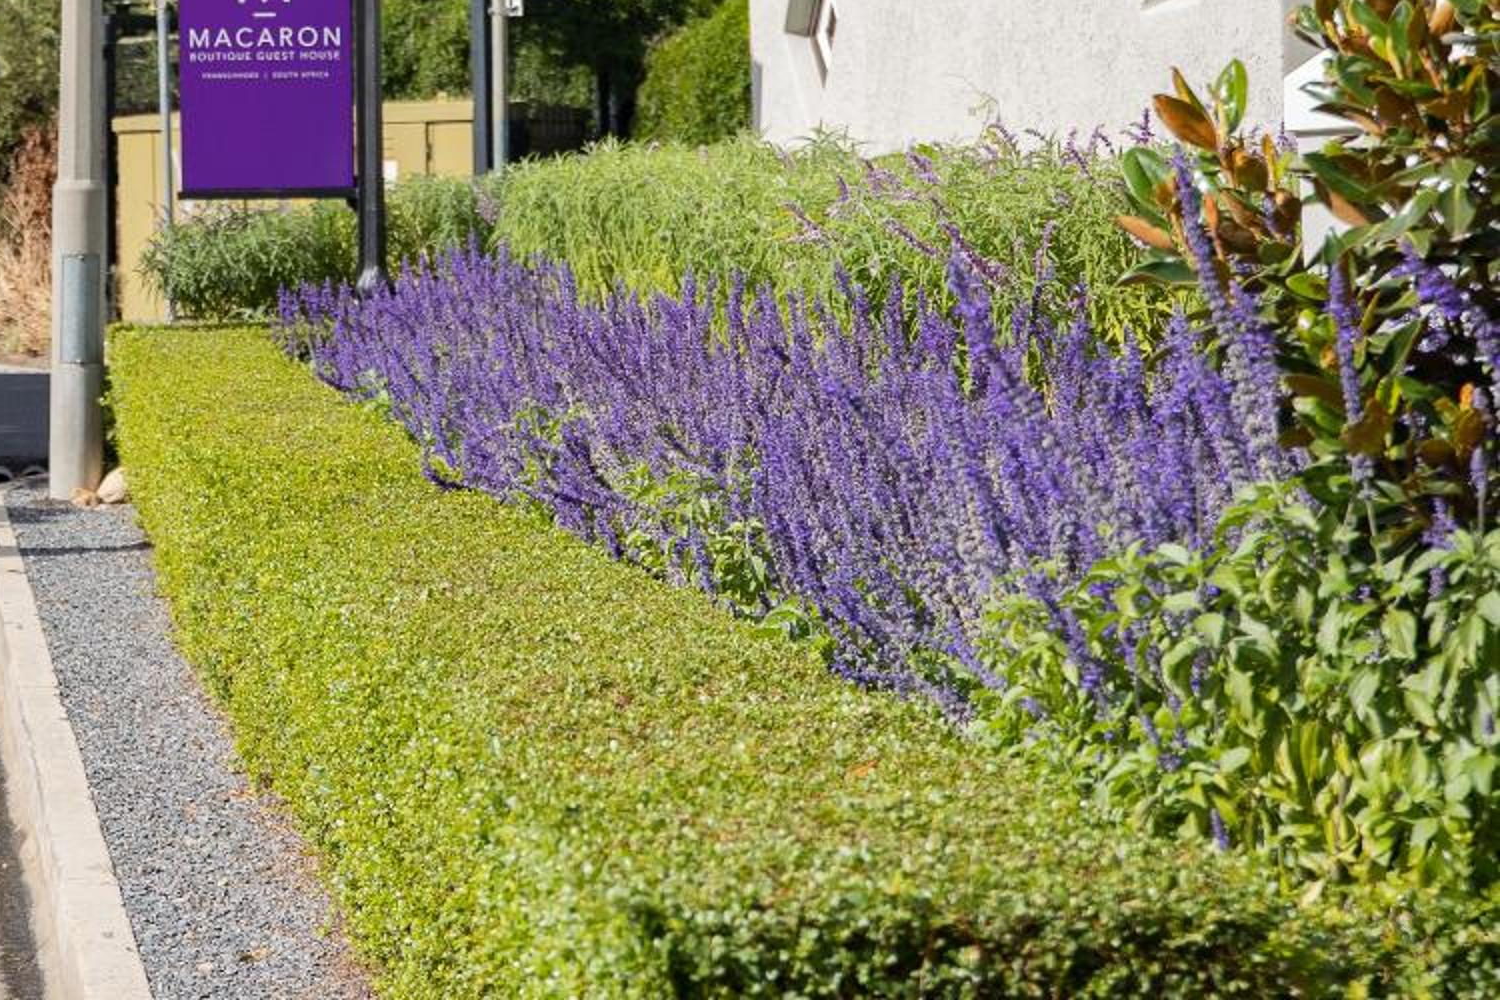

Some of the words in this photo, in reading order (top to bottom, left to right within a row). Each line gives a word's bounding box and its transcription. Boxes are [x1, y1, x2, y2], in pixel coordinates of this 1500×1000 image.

[189, 26, 342, 49] MACARON
[189, 51, 252, 63] BOUTIQUE
[256, 50, 296, 62] GUEST
[299, 50, 341, 61] HOUSE
